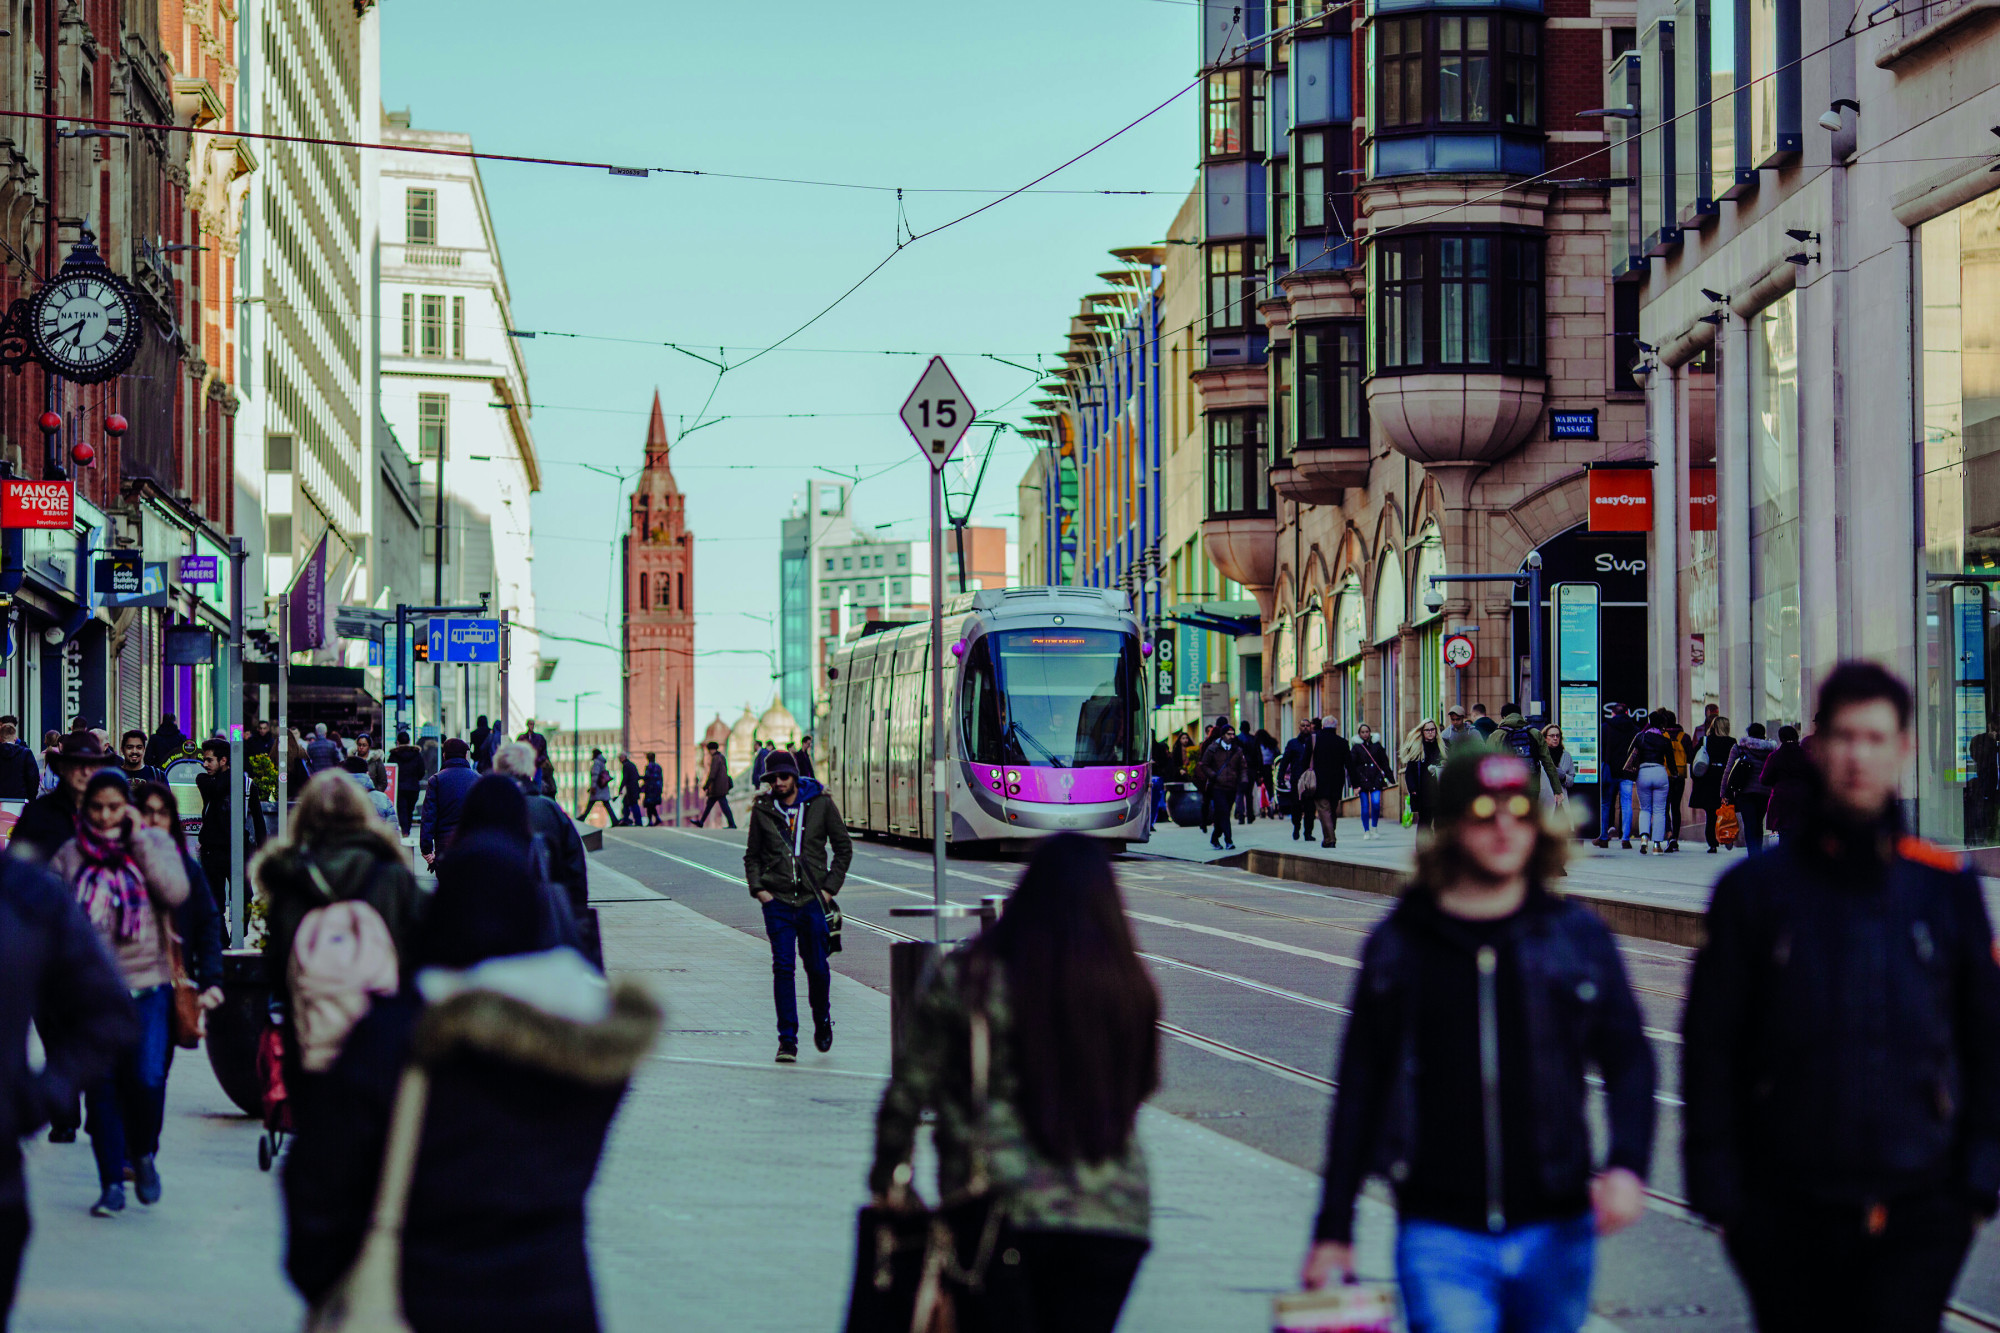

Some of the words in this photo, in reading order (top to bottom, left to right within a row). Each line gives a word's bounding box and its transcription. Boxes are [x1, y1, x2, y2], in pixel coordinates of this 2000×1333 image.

[61, 311, 99, 319] NATHAN
[918, 399, 957, 428] 15
[10, 484, 69, 497] MANGA
[20, 497, 69, 510] STORE
[1595, 494, 1647, 506] easyGym
[181, 570, 214, 579] AREERS
[113, 577, 139, 585] Building
[113, 583, 138, 591] Society
[1188, 625, 1199, 692] Poundland
